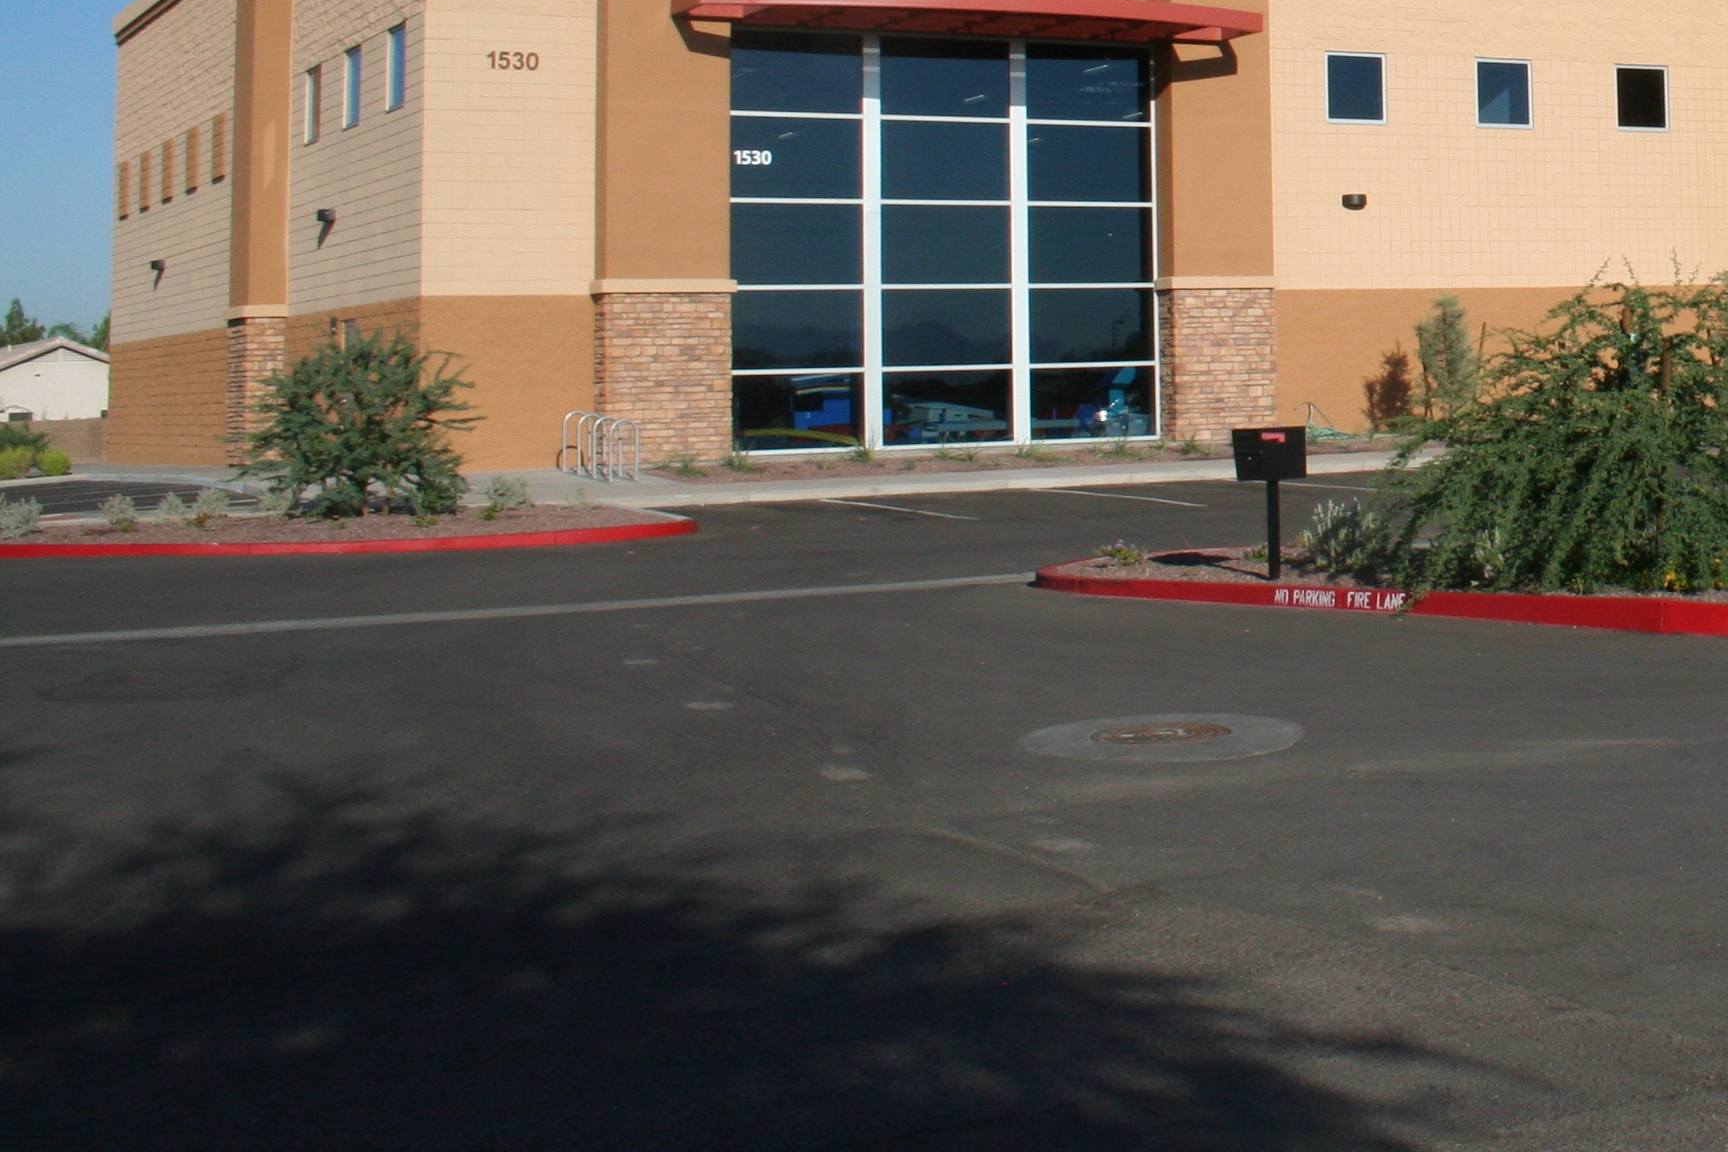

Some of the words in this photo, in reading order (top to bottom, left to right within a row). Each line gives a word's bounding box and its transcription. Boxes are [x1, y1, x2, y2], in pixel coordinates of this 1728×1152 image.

[486, 50, 540, 71] 1530
[733, 149, 773, 166] 1530
[1274, 589, 1289, 605] NO
[1293, 589, 1336, 607] PARKING
[1347, 591, 1372, 609] FIRE
